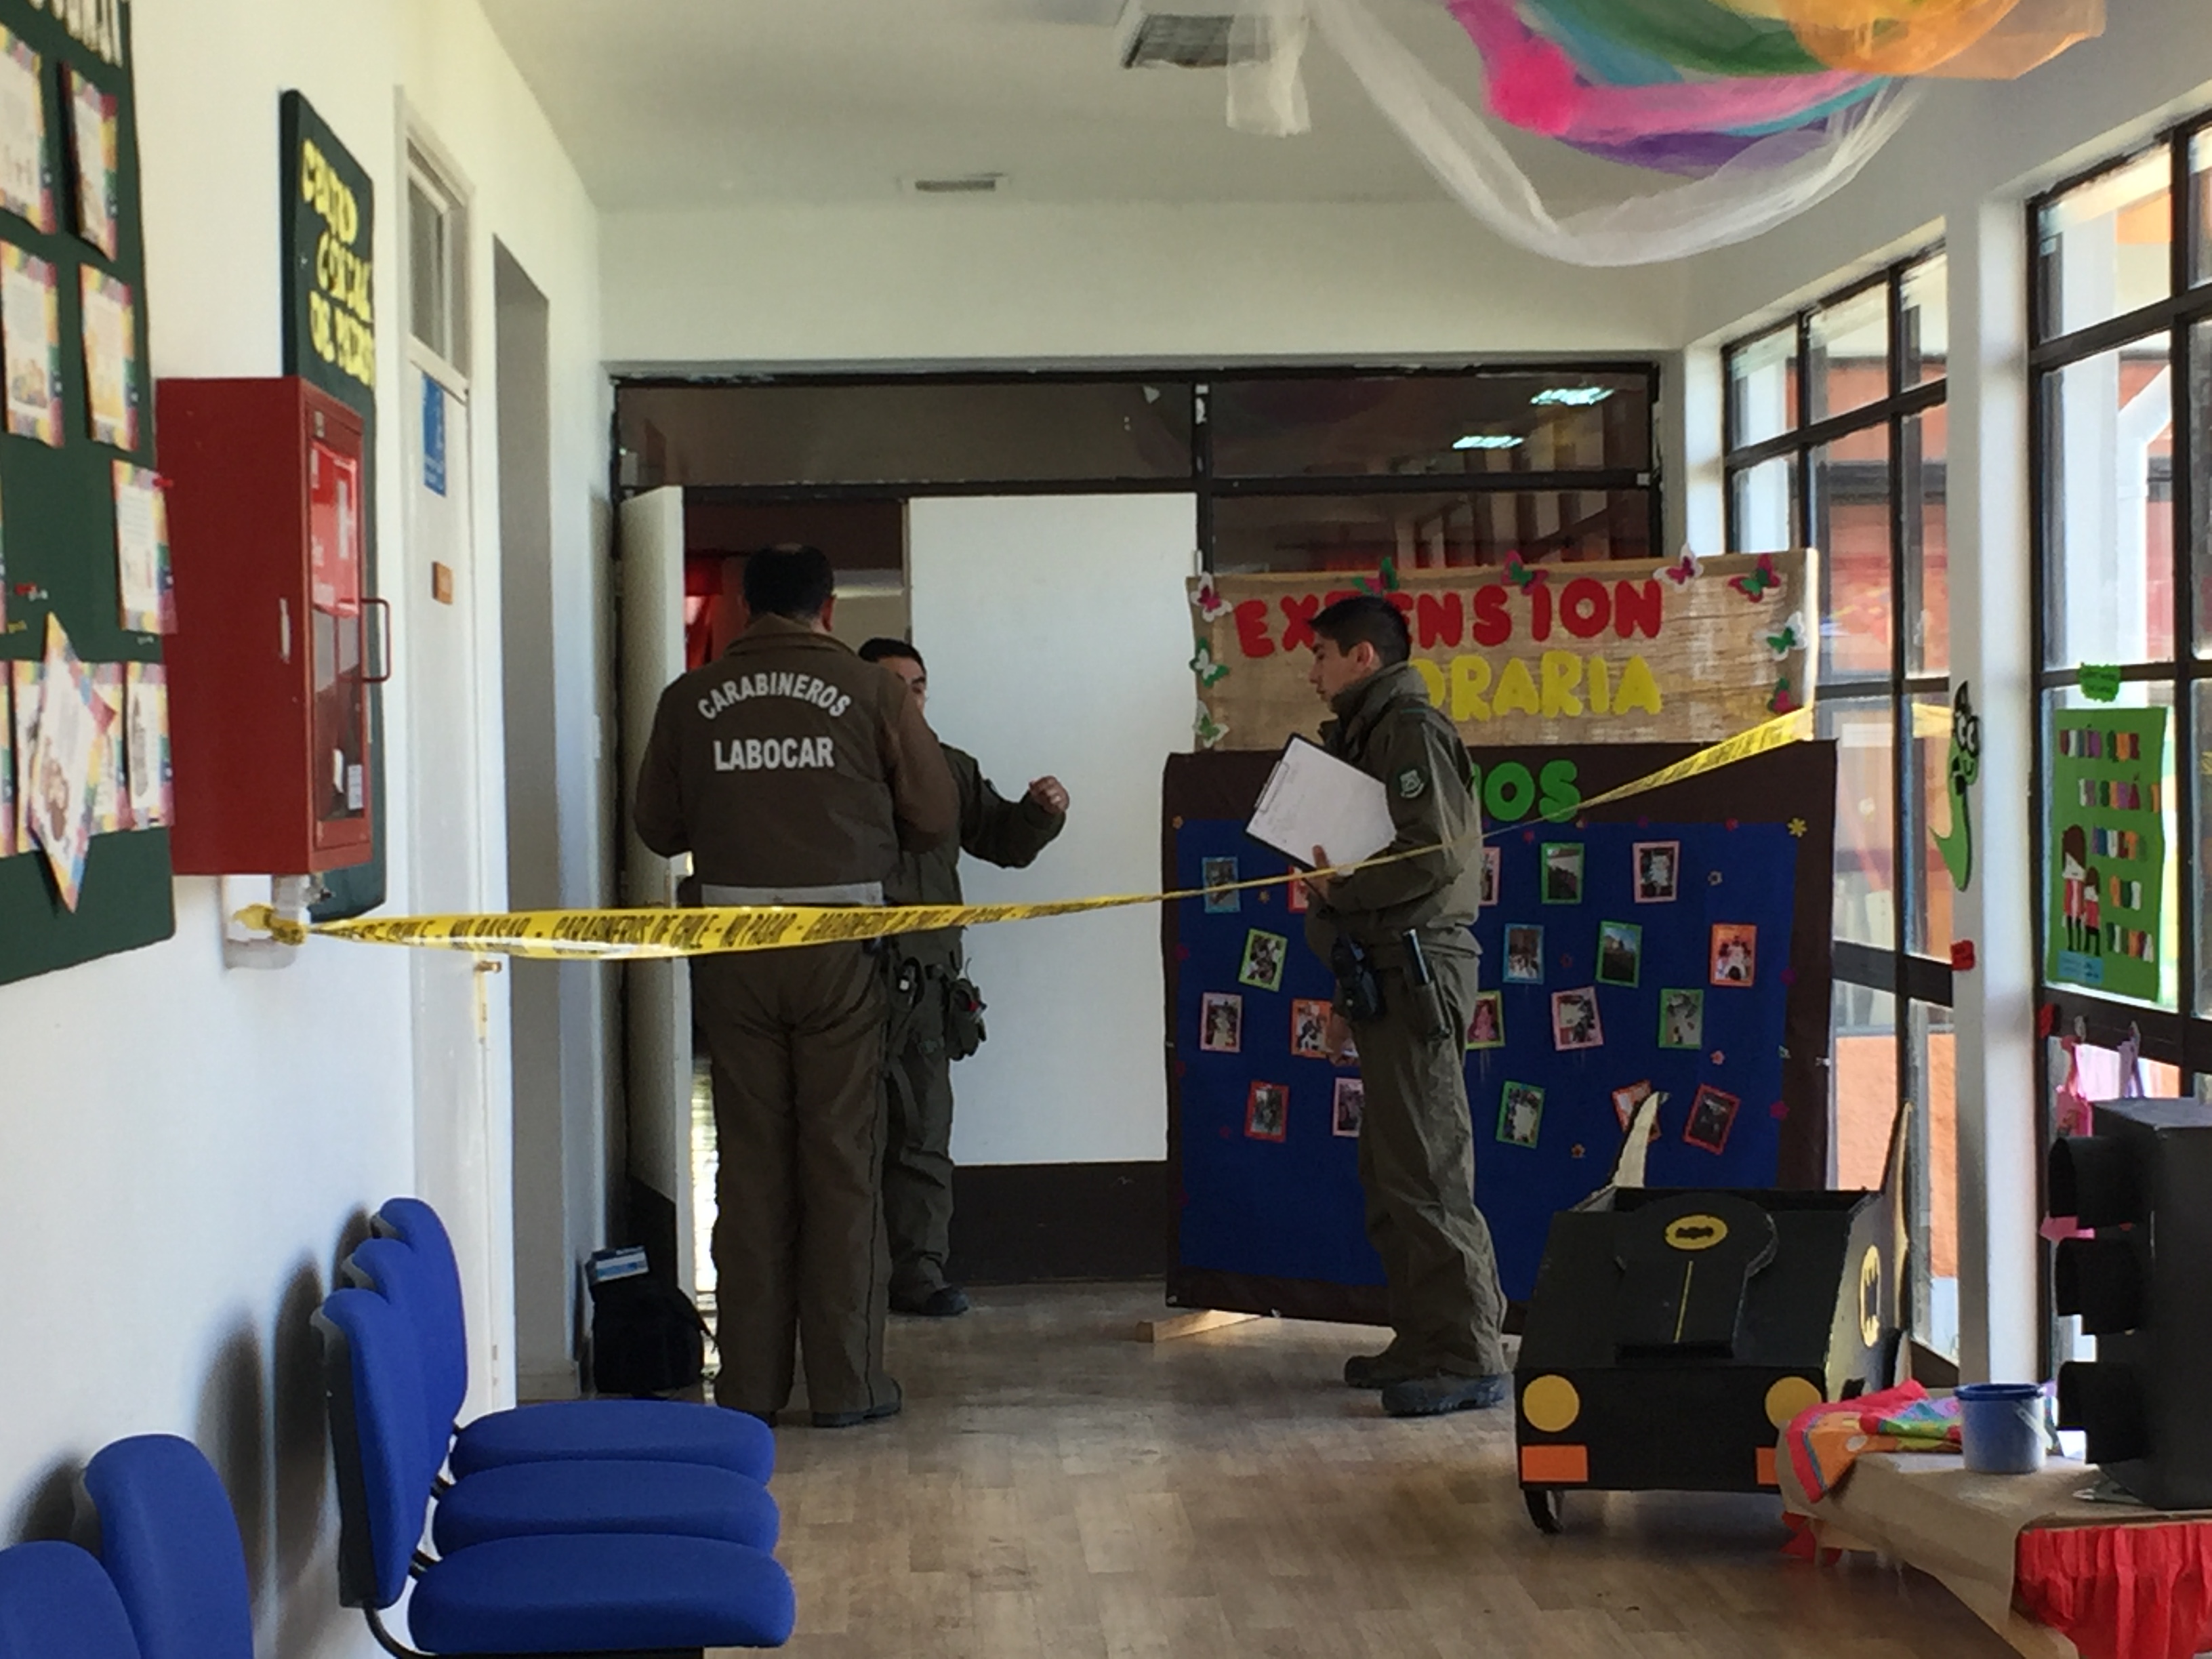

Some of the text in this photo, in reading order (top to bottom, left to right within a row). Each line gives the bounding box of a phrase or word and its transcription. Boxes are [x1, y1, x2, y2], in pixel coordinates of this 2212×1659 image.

[698, 672, 851, 719] CARABINEROS
[714, 737, 835, 771] LABOCAR
[1472, 760, 1582, 823] OS
